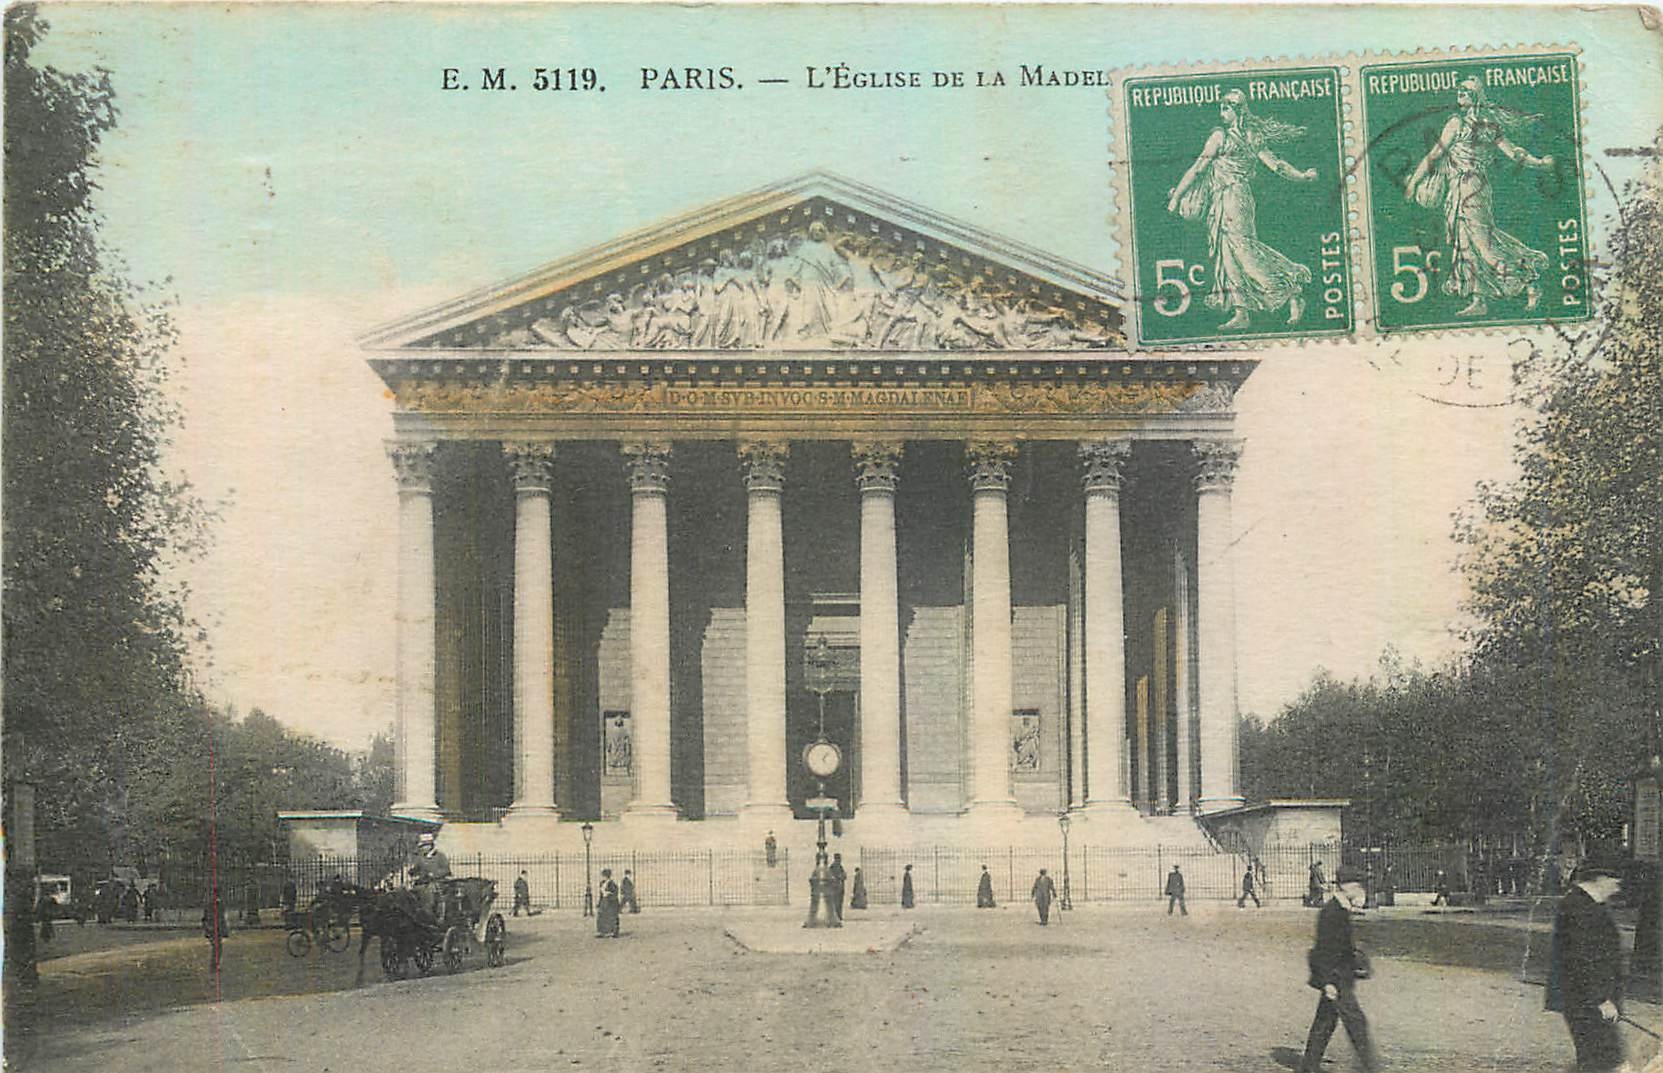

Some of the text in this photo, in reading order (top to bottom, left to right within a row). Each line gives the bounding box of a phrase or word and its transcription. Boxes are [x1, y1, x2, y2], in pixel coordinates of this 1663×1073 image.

[1249, 77, 1331, 101] FRANÇAISE
[1486, 63, 1569, 87] FRANÇAISE
[1322, 231, 1344, 320] POSTES
[1558, 218, 1581, 306] POSTES
